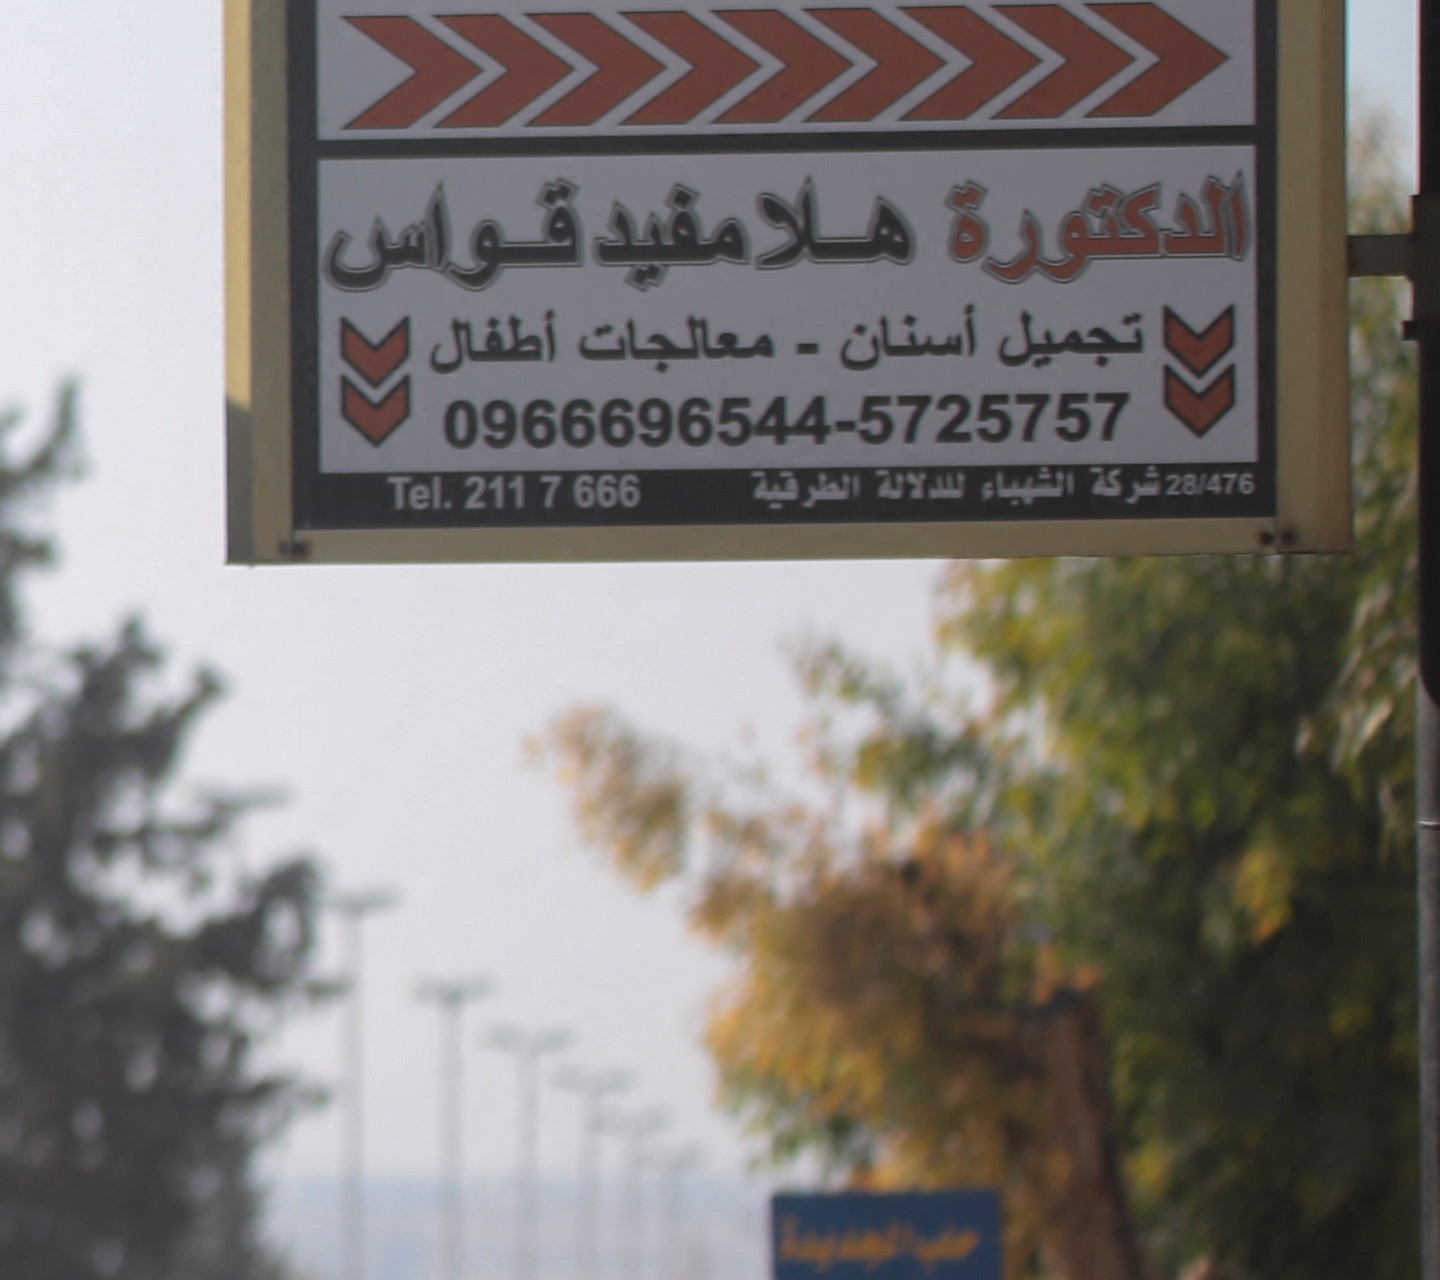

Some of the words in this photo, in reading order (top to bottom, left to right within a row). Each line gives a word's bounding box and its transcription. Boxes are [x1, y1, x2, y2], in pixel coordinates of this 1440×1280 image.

[325, 178, 581, 292] قواس
[595, 184, 748, 291] مفيد
[944, 172, 1251, 284] الدكتورة
[430, 310, 555, 374] أطفال
[579, 316, 774, 372] معالجات
[841, 304, 975, 370] أسنان
[999, 312, 1143, 368] تجميل
[445, 392, 1130, 449] 0966696544-5725757
[387, 477, 451, 509] Tel.
[465, 476, 523, 509] 211
[540, 476, 561, 508] 7
[574, 474, 639, 508] 666
[752, 472, 859, 509] الطرقية
[876, 470, 965, 499] للدلالة
[983, 467, 1073, 504] الشهباء
[1090, 468, 1159, 502] شركة
